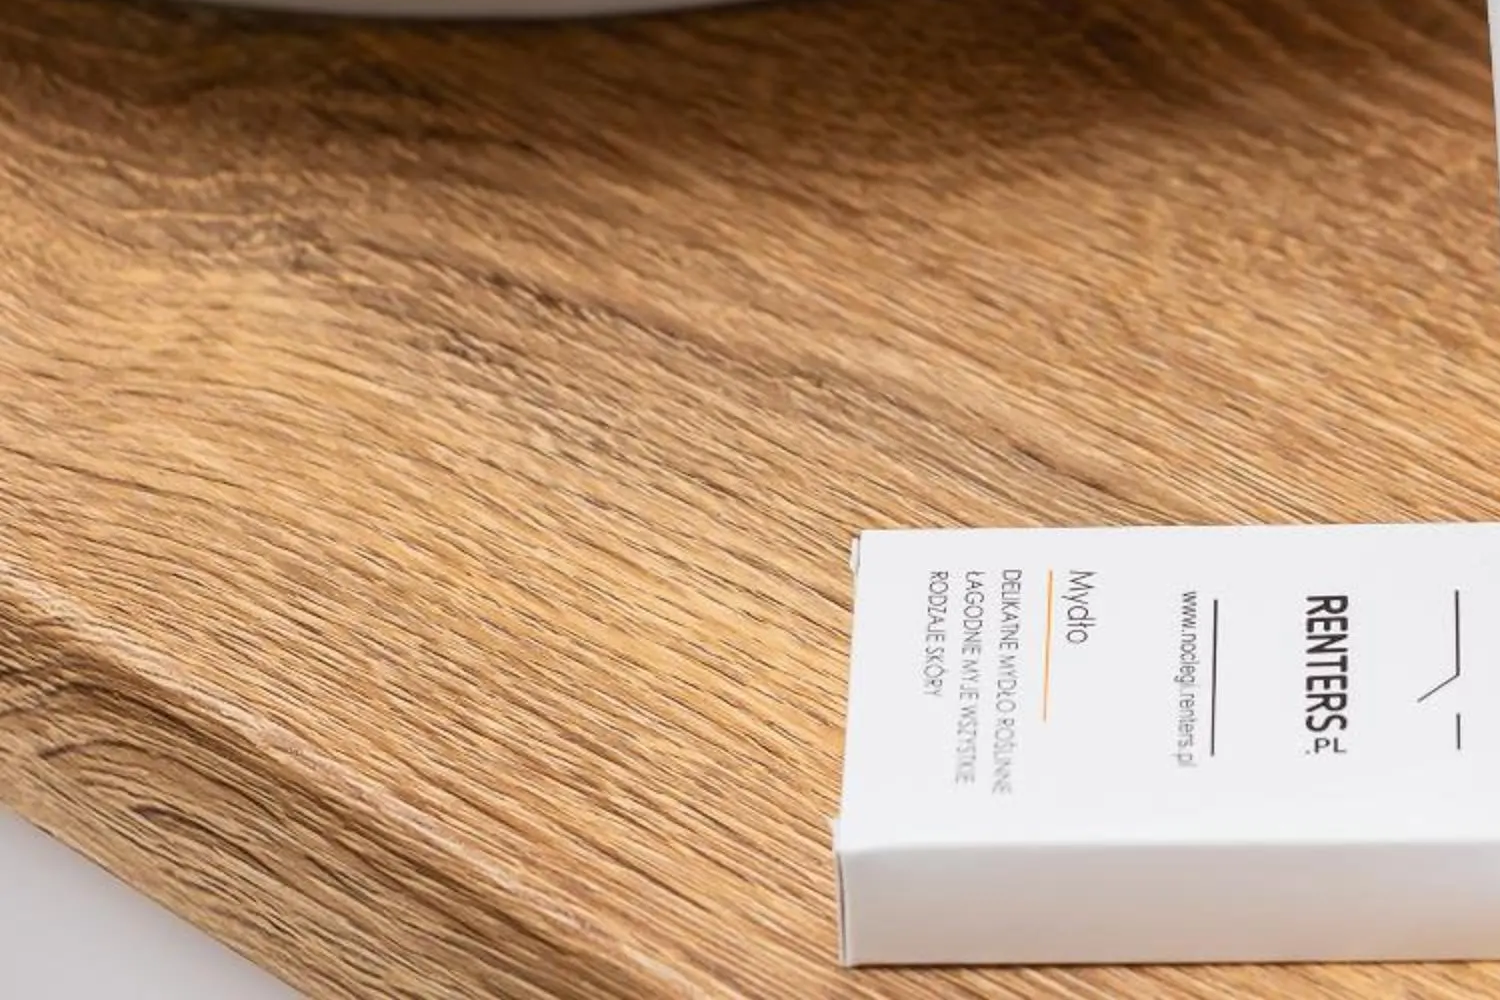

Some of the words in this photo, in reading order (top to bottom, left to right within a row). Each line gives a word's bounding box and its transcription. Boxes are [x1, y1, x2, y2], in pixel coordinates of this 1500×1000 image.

[925, 570, 949, 643] RODZAJE
[961, 570, 985, 655] ŁAGODNIE
[999, 569, 1022, 651] DELIKATNE
[1061, 569, 1097, 645] Mydło
[923, 646, 949, 697] SKÓRY
[959, 658, 980, 701] MYJE
[996, 655, 1017, 714] MYDŁO
[1174, 591, 1199, 768] www.noclegi.renters.pl
[1306, 595, 1349, 732] RENTERS
